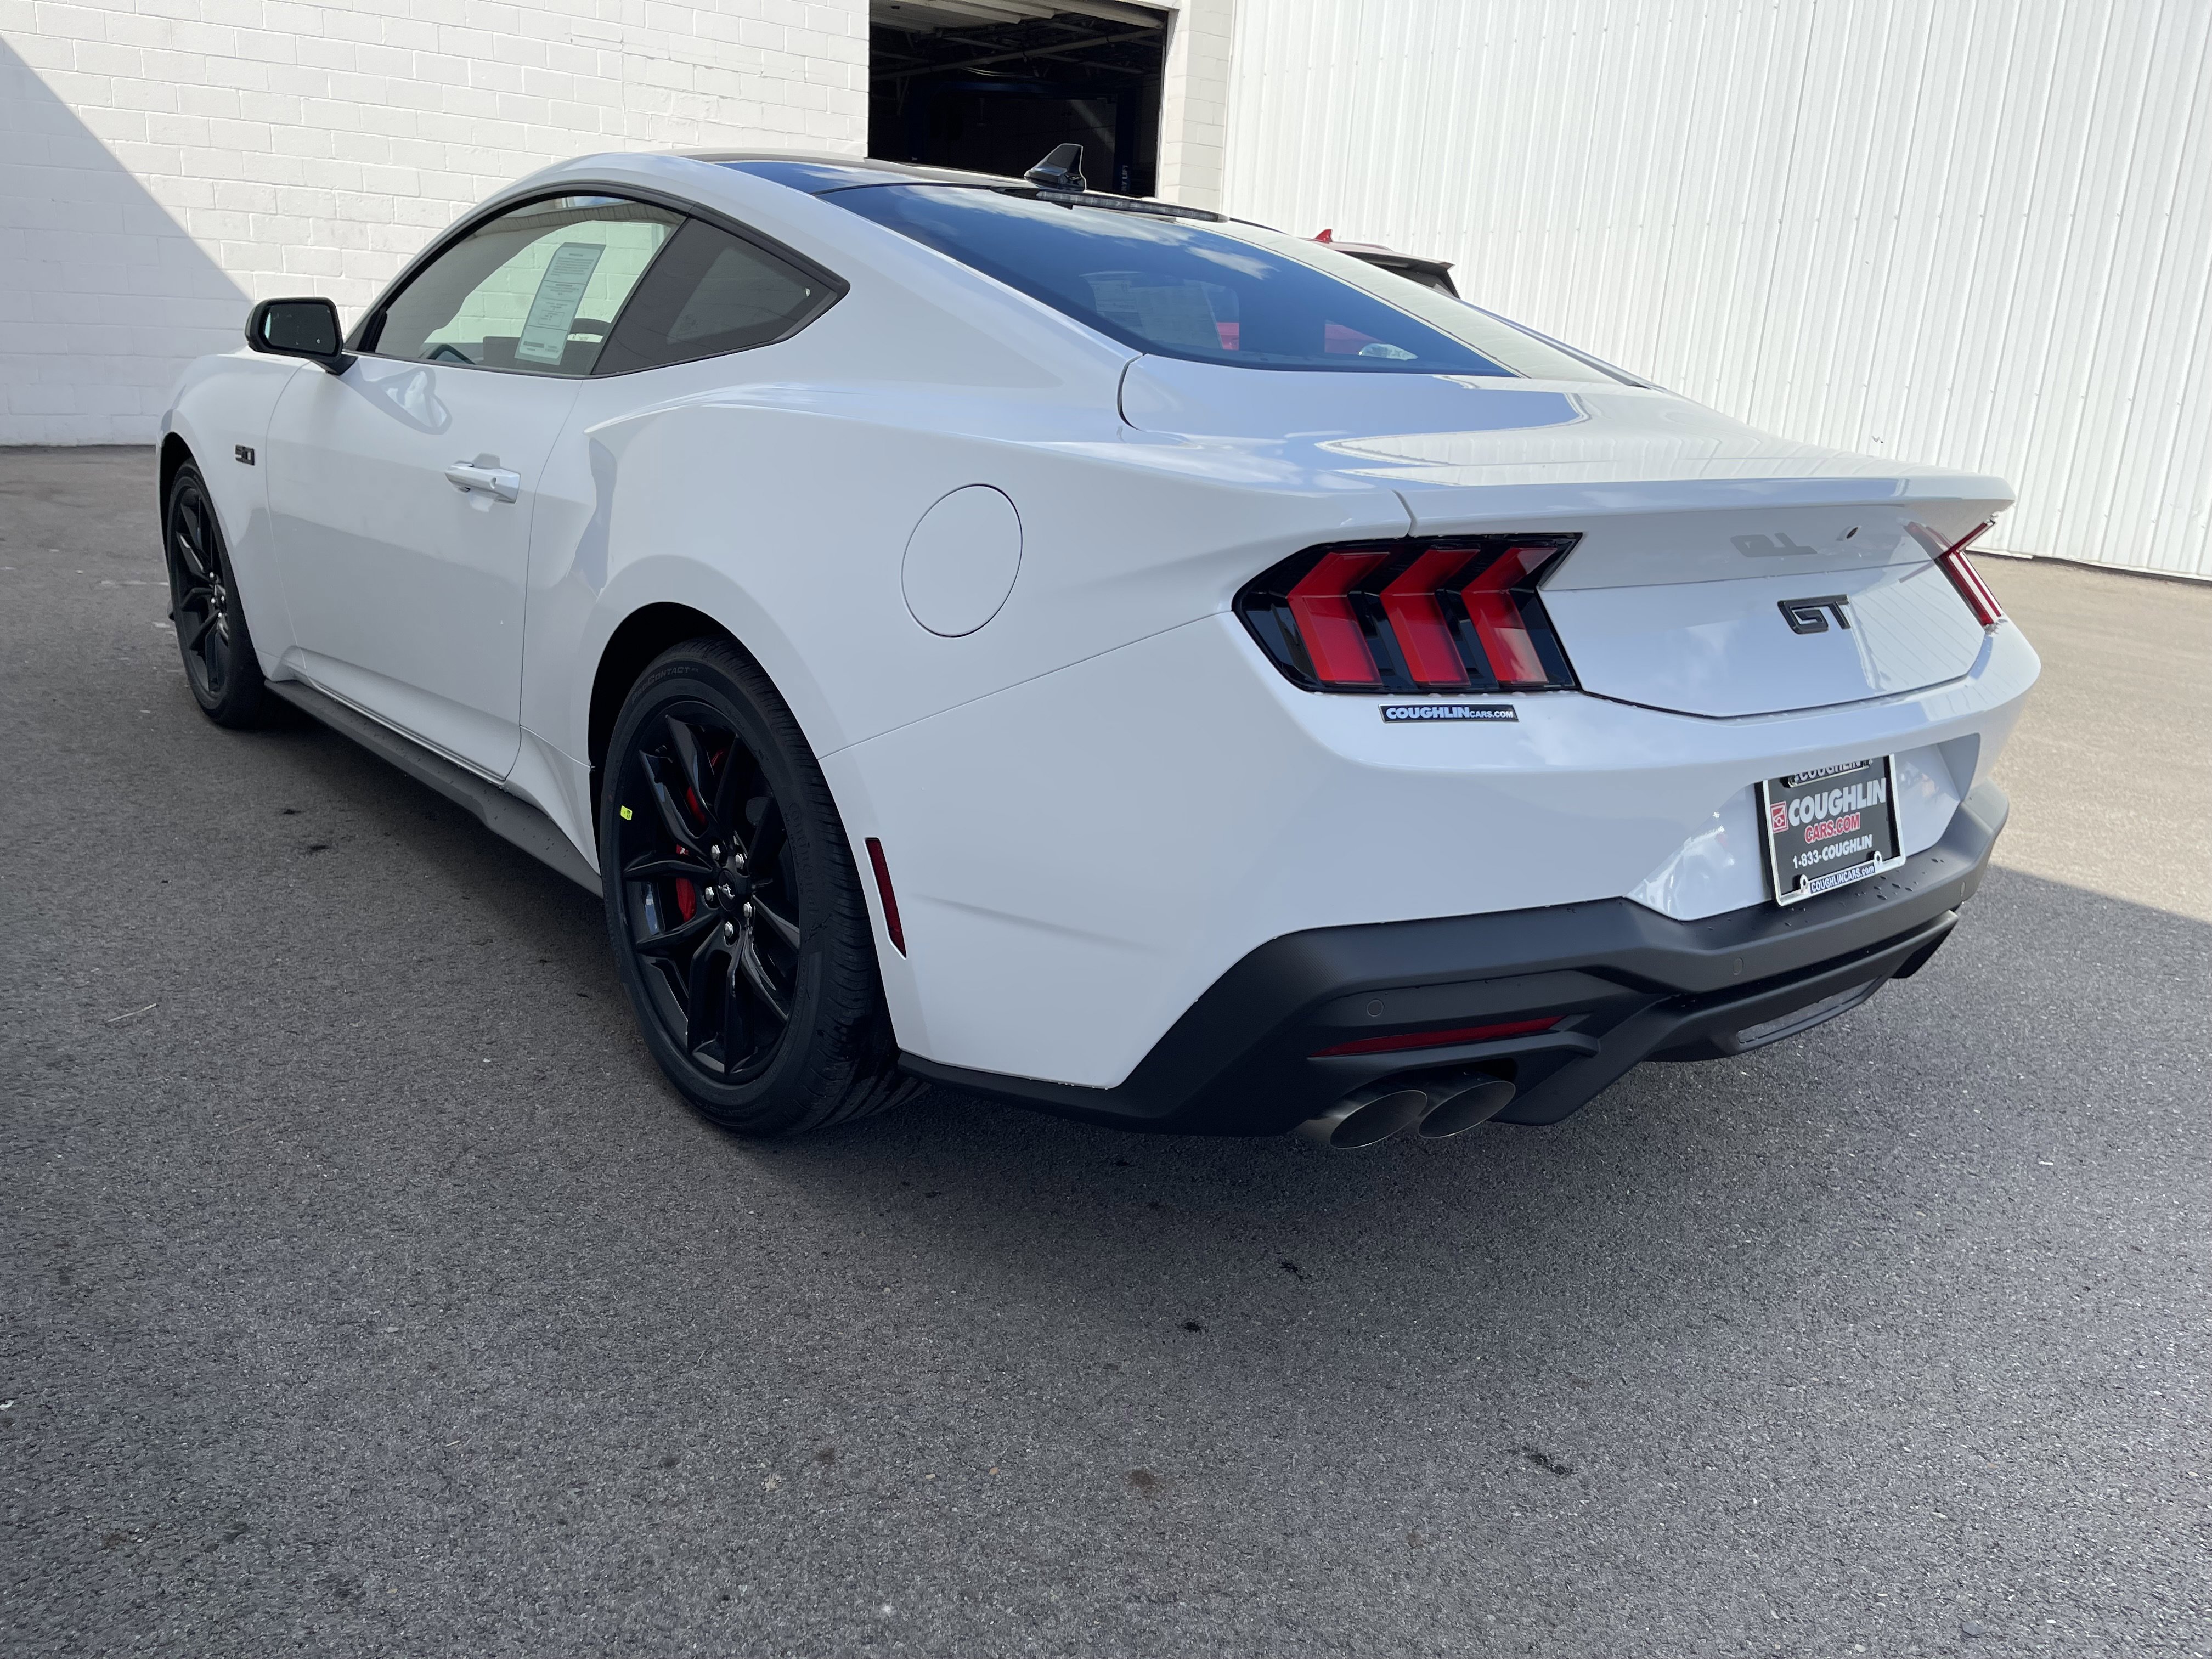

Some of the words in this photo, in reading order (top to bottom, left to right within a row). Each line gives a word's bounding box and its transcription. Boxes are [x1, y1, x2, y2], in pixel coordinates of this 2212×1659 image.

[1777, 594, 1851, 635] GT
[1385, 706, 1514, 719] COUGHLINCARS.COM
[1788, 777, 1887, 827] COUGHLIN
[1804, 812, 1860, 844] CARS.COM
[1792, 834, 1872, 869] 1-833-COUGHLIN
[1811, 865, 1875, 893] COUGHLINCARS.com
